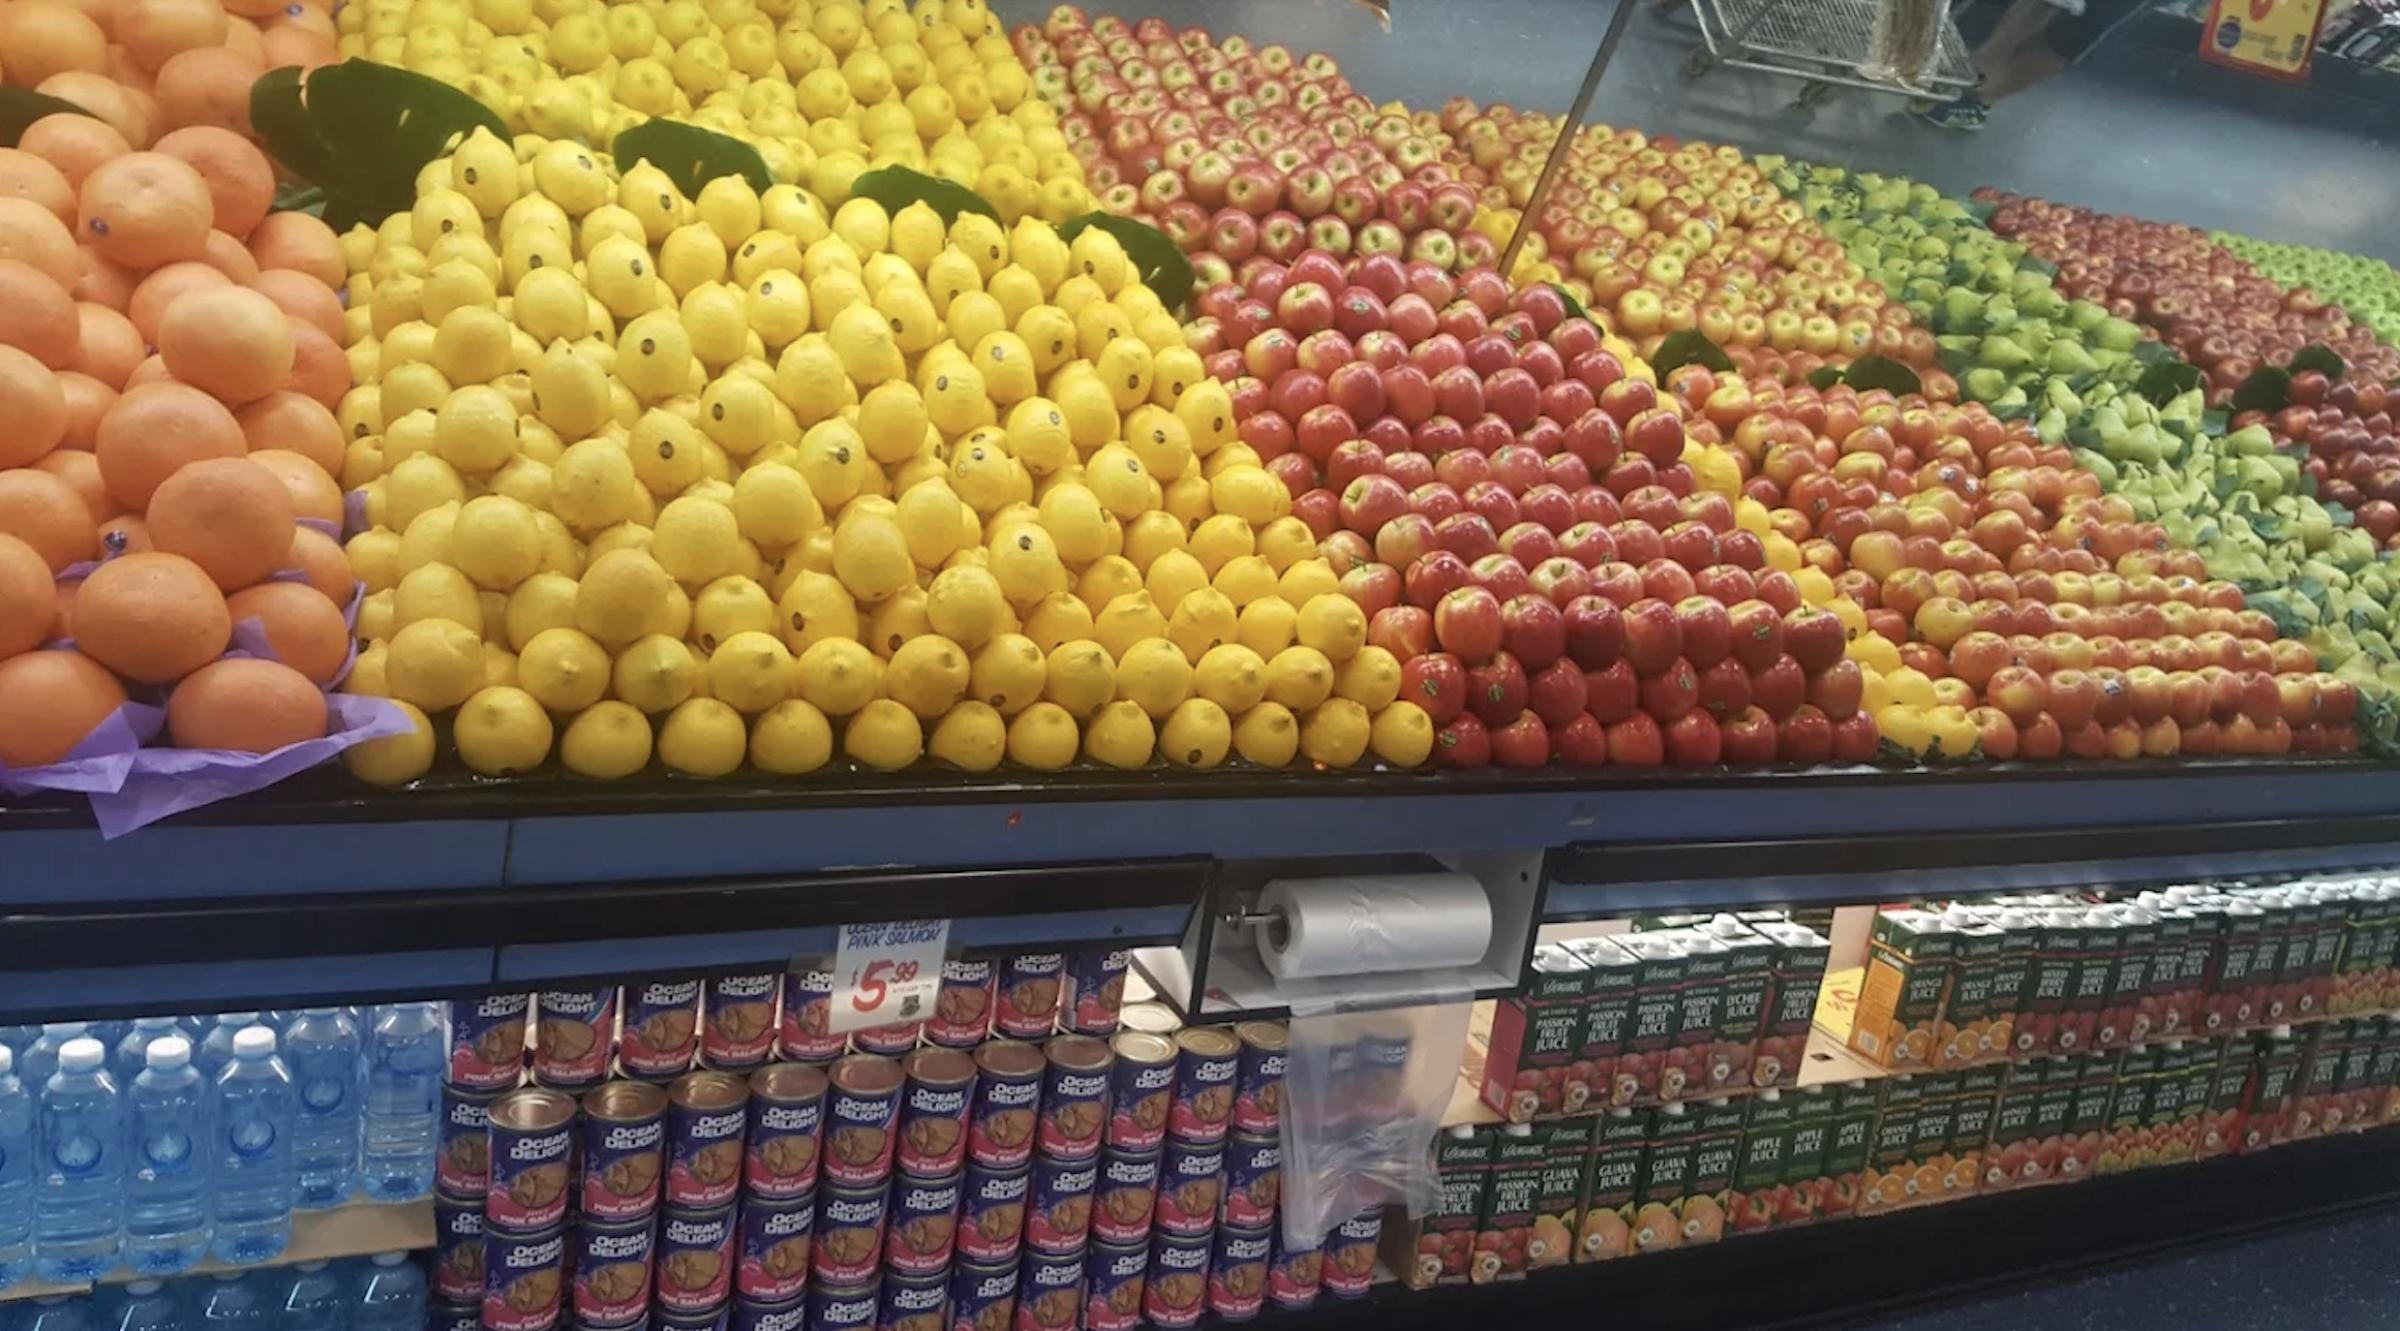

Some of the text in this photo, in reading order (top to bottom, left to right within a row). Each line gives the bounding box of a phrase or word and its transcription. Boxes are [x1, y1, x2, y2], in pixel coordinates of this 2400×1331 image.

[847, 927, 941, 950] PINK SALMON
[1994, 980, 2018, 993] JUICE
[1683, 995, 1719, 1009] PASSION
[1727, 993, 1761, 1006] LYCHEE
[1910, 988, 1936, 1002] JUICE
[1961, 989, 1986, 1003] JUICE
[1587, 1010, 1627, 1022] PASSION
[1637, 1003, 1674, 1015] PASSION
[1726, 1005, 1756, 1019] JUICE
[1781, 1006, 1808, 1022] JUICE
[1536, 1017, 1577, 1031] PASSION
[1591, 1020, 1619, 1031] FRUIT
[1637, 1022, 1667, 1037] JUICE
[1682, 1015, 1712, 1031] JUICE
[1540, 1027, 1567, 1039] FRUIT
[1587, 1029, 1619, 1044] JUICE
[1536, 1038, 1569, 1052] JUICE
[994, 1081, 1037, 1096] OCEAN
[1064, 1075, 1106, 1089] OCEAN
[916, 1088, 962, 1101] OCEAN
[841, 1097, 887, 1111] OCEAN
[911, 1096, 963, 1112] DELIGHT
[699, 1111, 744, 1128] OCEAN
[768, 1106, 816, 1120] OCEAN
[835, 1103, 889, 1121] DELIGHT
[1957, 1110, 1990, 1122] ORANGE
[762, 1114, 818, 1129] DELIGHT
[1840, 1121, 1865, 1135] APPLE
[1917, 1115, 1950, 1128] ORANGE
[1957, 1120, 1983, 1133] JUICE
[2001, 1115, 2027, 1128] JUICE
[612, 1121, 661, 1139] OCEAN
[1795, 1128, 1824, 1142] APPLE
[1881, 1123, 1914, 1136] ORANGE
[1918, 1125, 1945, 1139] JUICE
[518, 1130, 568, 1150] OCEAN
[606, 1130, 662, 1148] DELIGHT
[1753, 1137, 1782, 1150] APPLE
[1837, 1133, 1862, 1149] JUICE
[1882, 1134, 1908, 1147] JUICE
[511, 1139, 571, 1159] DELIGHT
[1793, 1141, 1821, 1156] JUICE
[1698, 1150, 1733, 1165] GUAVA
[1751, 1149, 1779, 1164] JUICE
[1113, 1161, 1155, 1174] OCEAN
[1598, 1162, 1637, 1178] GUAVA
[1651, 1157, 1687, 1172] GUAVA
[1698, 1162, 1728, 1178] JUICE
[1542, 1167, 1579, 1183] GUAVA
[1600, 1174, 1632, 1190] JUICE
[1652, 1169, 1683, 1184] JUICE
[1443, 1182, 1481, 1193] ASSION
[1495, 1179, 1540, 1193] PASSION
[1543, 1179, 1574, 1194] JUICE
[912, 1187, 956, 1201] OCEAN
[1501, 1189, 1530, 1200] FRUIT
[827, 1206, 881, 1222] DELIGHT
[833, 1200, 880, 1214] OCEAN
[1496, 1200, 1531, 1216] JUICE
[672, 1220, 722, 1235] OCEAN
[595, 1231, 647, 1247] OCEAN
[666, 1228, 724, 1245] DELIGHT
[588, 1240, 649, 1258] DELIGHT
[1167, 1247, 1207, 1260] OCEAN
[1042, 1260, 1082, 1276] OCEAN
[901, 1285, 944, 1300] OCEAN
[831, 1298, 875, 1313] OCEAN
